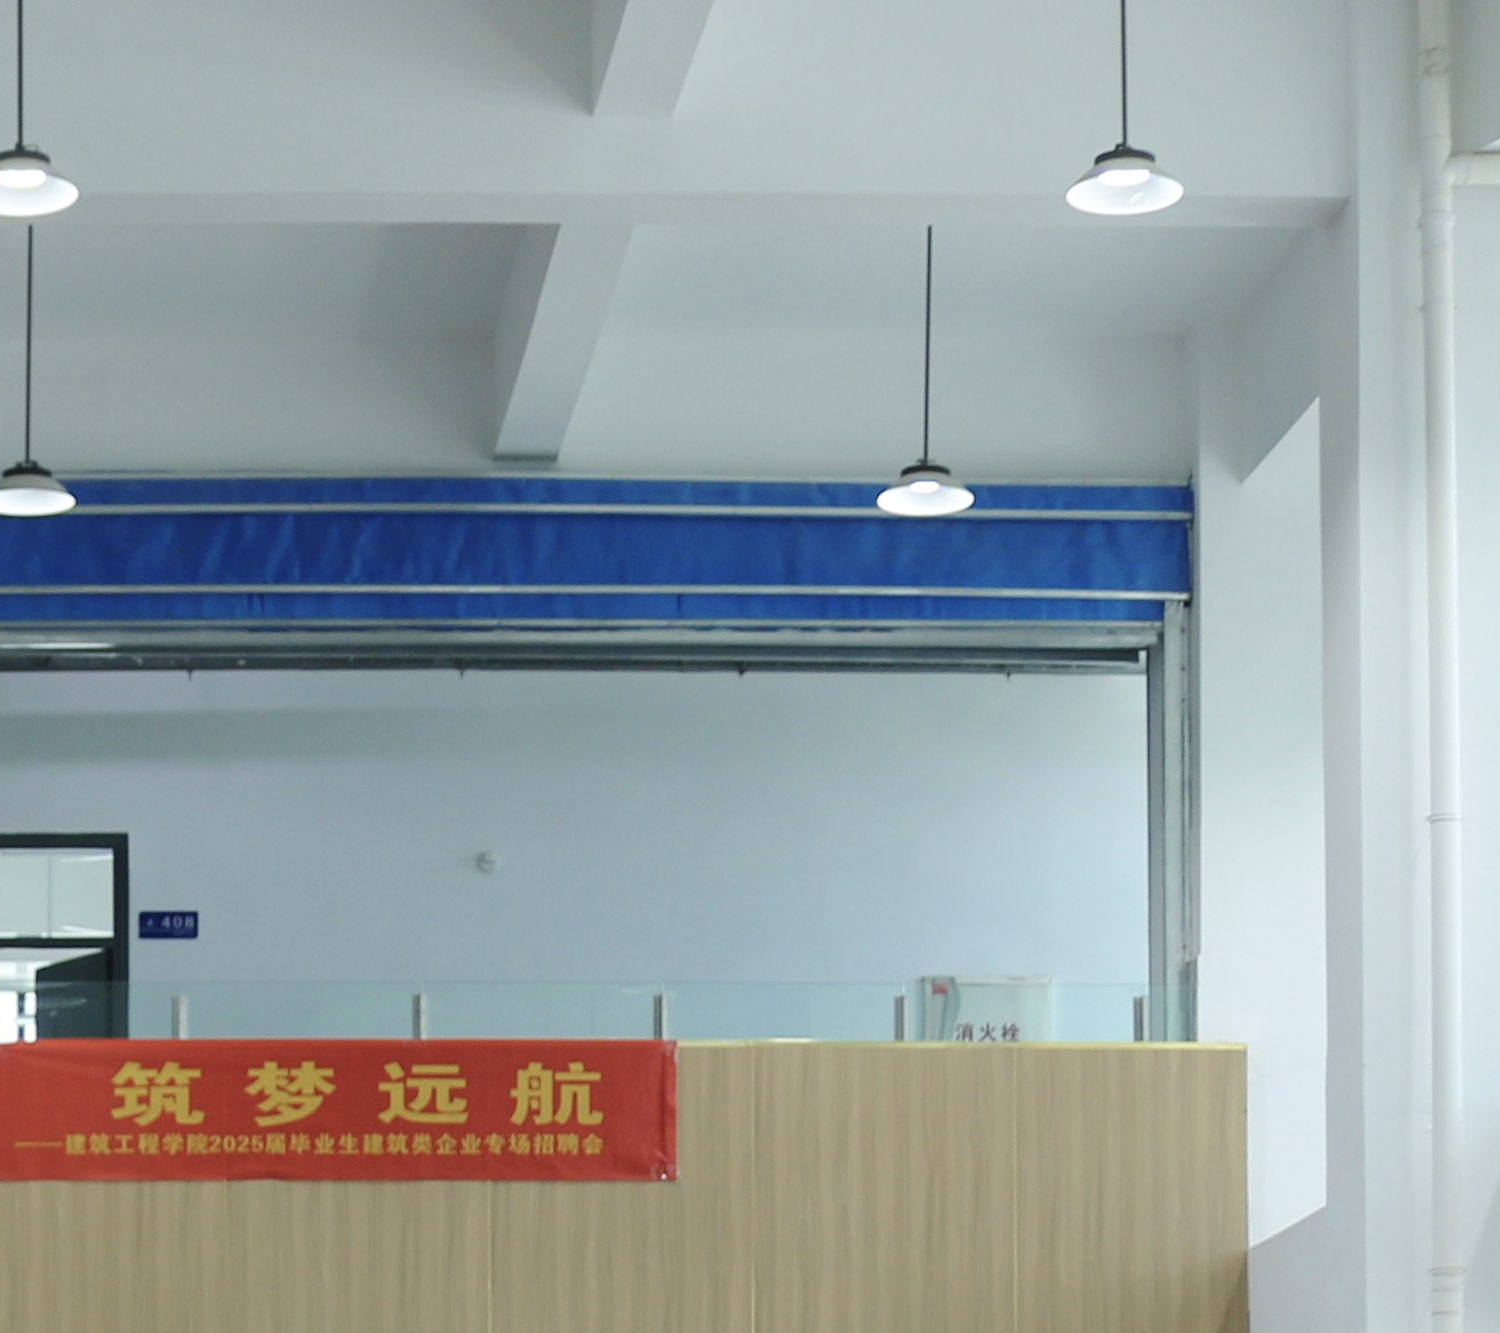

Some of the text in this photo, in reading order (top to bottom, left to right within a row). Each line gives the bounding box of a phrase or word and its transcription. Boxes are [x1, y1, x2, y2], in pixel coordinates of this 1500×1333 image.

[955, 1022, 1019, 1041] 消火栓
[111, 1061, 604, 1127] 筑梦远航
